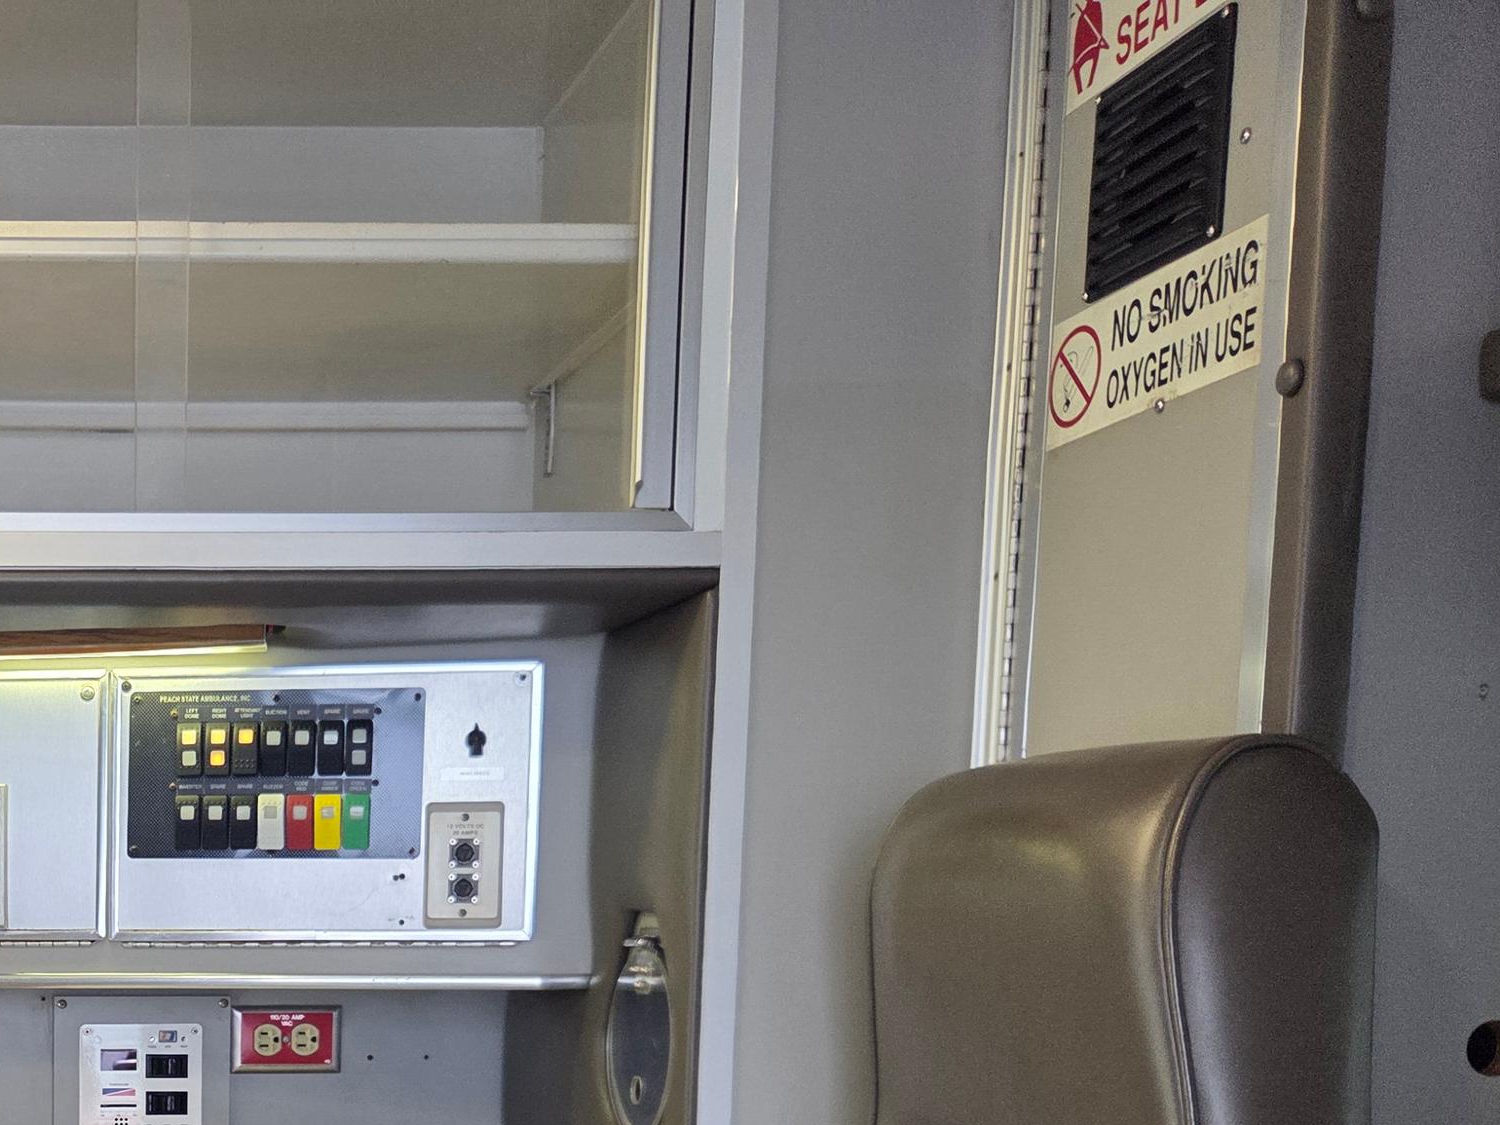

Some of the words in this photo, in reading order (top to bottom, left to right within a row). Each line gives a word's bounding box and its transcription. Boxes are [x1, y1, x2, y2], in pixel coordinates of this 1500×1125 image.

[1111, 298, 1143, 351] NO
[1148, 239, 1259, 333] SMOKING
[1106, 338, 1184, 408] OXYGEN
[1188, 327, 1209, 374] IN
[1215, 306, 1257, 363] USE
[160, 695, 180, 703] PEACH
[181, 695, 199, 703] STATE
